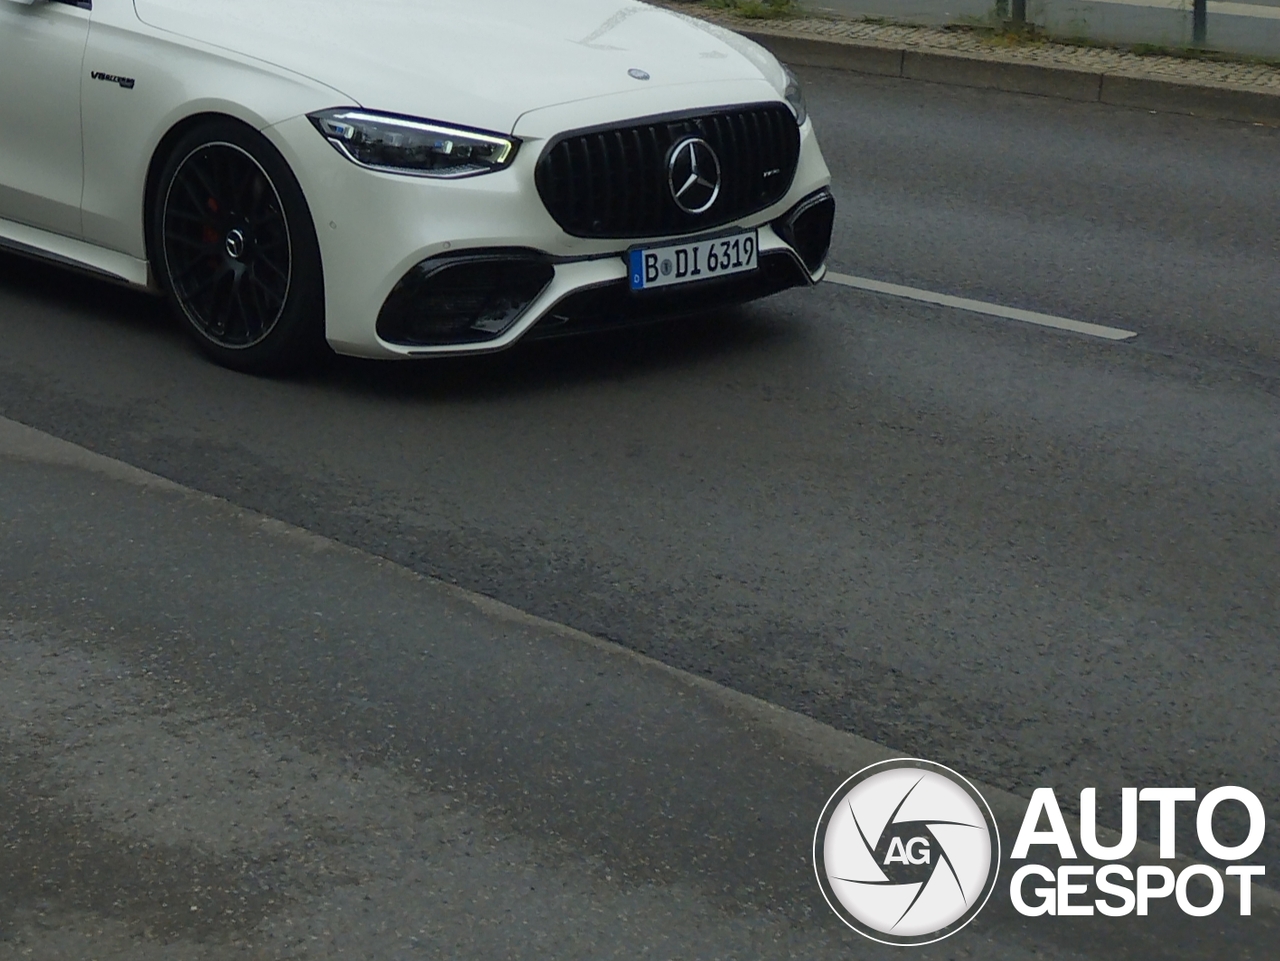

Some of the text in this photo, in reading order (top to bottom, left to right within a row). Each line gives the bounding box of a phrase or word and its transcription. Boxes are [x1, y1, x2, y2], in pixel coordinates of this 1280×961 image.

[644, 236, 754, 283] B DI 6319
